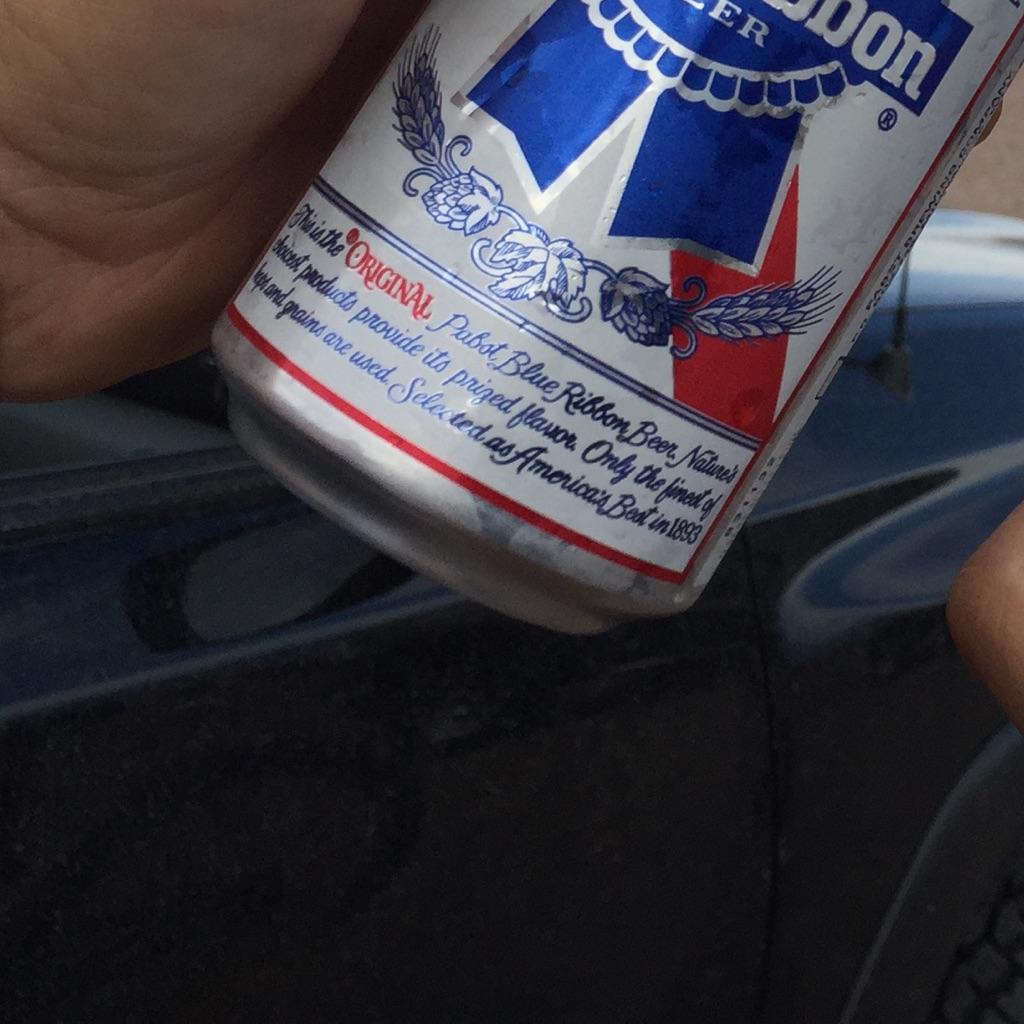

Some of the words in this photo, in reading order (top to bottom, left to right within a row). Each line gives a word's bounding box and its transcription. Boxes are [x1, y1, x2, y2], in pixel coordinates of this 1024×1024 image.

[263, 283, 296, 308] and
[275, 299, 329, 338] grains
[317, 229, 346, 257] the
[425, 312, 509, 362] Pabst
[486, 349, 560, 395] Blue
[541, 381, 631, 435] Ribbon
[665, 444, 740, 484] Nature's
[322, 331, 354, 356] are
[292, 263, 358, 312] products
[348, 306, 426, 357] provide
[422, 347, 452, 374] its
[442, 369, 524, 415] prized
[580, 439, 639, 486] Only
[633, 464, 667, 492] the
[653, 476, 714, 512] finest
[700, 493, 724, 523] of
[386, 376, 494, 443] Selected
[482, 436, 517, 457] as
[488, 446, 613, 508] America's
[595, 493, 660, 527] Best
[647, 513, 672, 535] in
[664, 517, 704, 546] 1893
